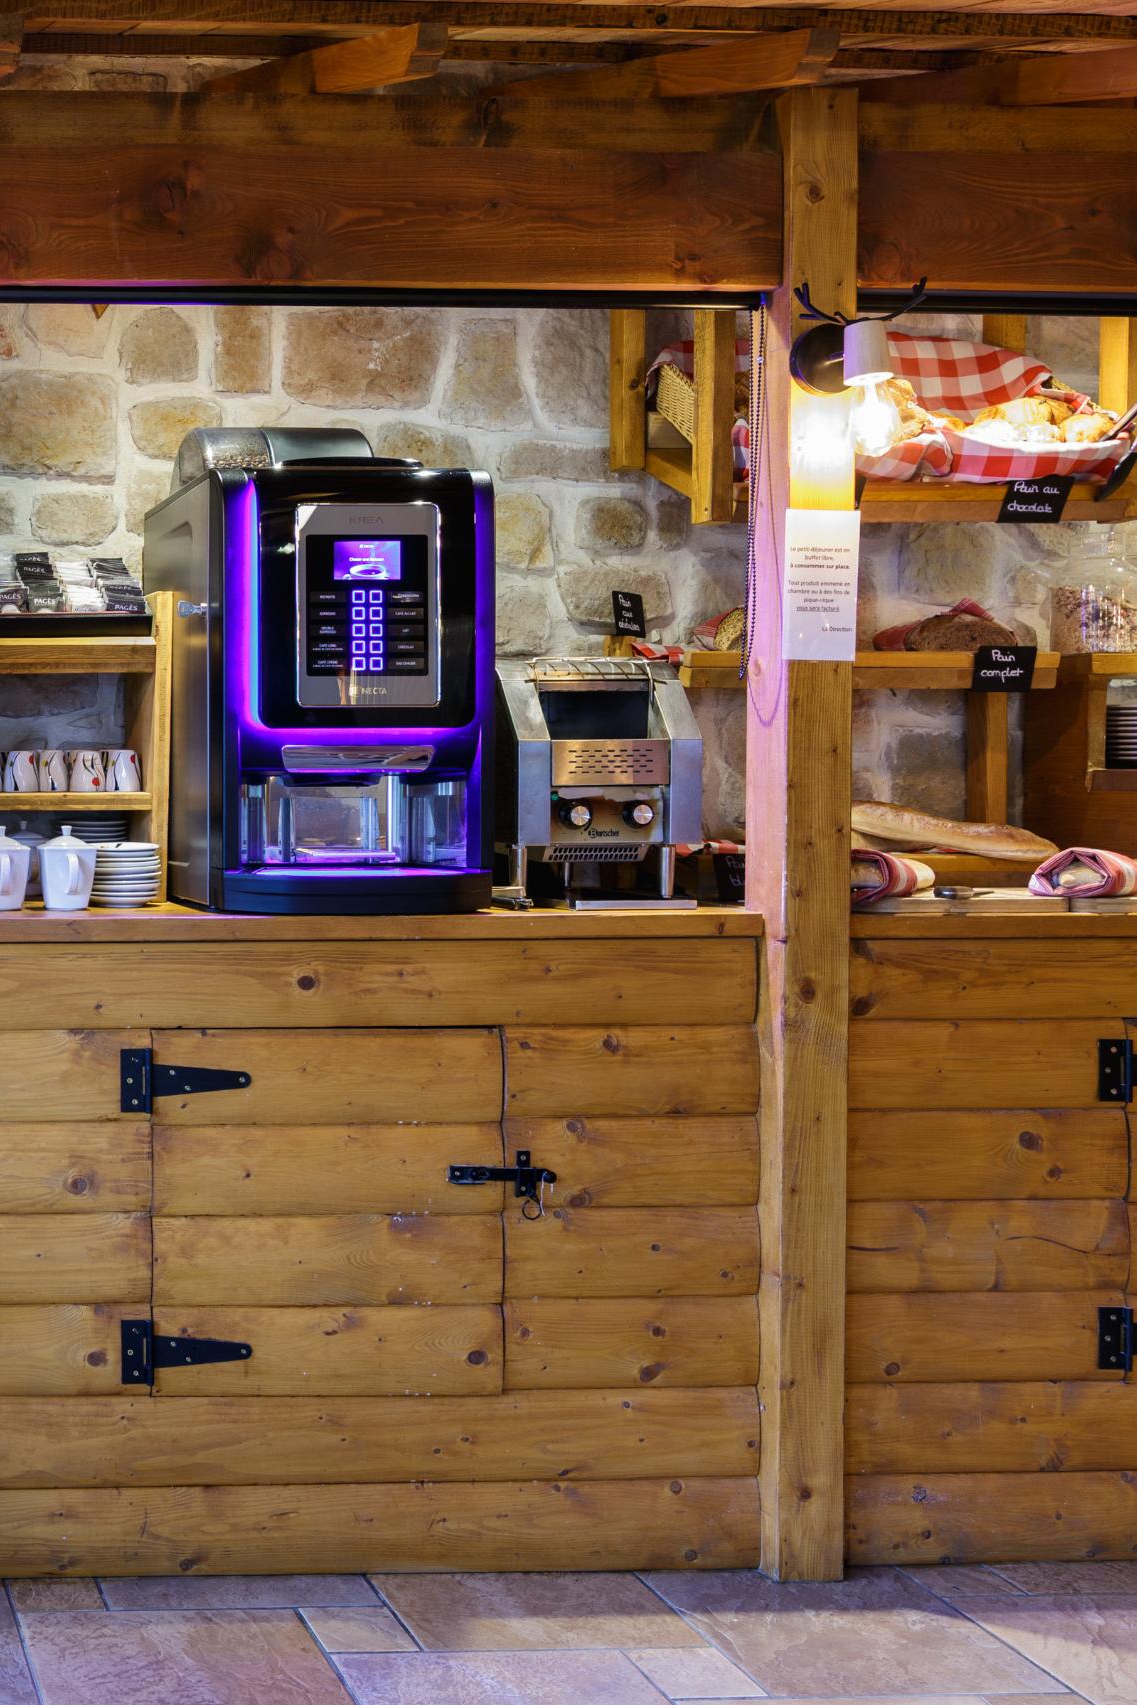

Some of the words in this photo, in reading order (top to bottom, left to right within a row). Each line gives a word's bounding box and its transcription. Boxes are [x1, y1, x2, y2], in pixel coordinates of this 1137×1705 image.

[1013, 480, 1039, 493] Pain
[1042, 486, 1060, 494] au
[1007, 499, 1053, 513] chocolat
[991, 649, 1016, 661] Pain
[980, 667, 1024, 683] complet
[361, 687, 387, 695] NECTA
